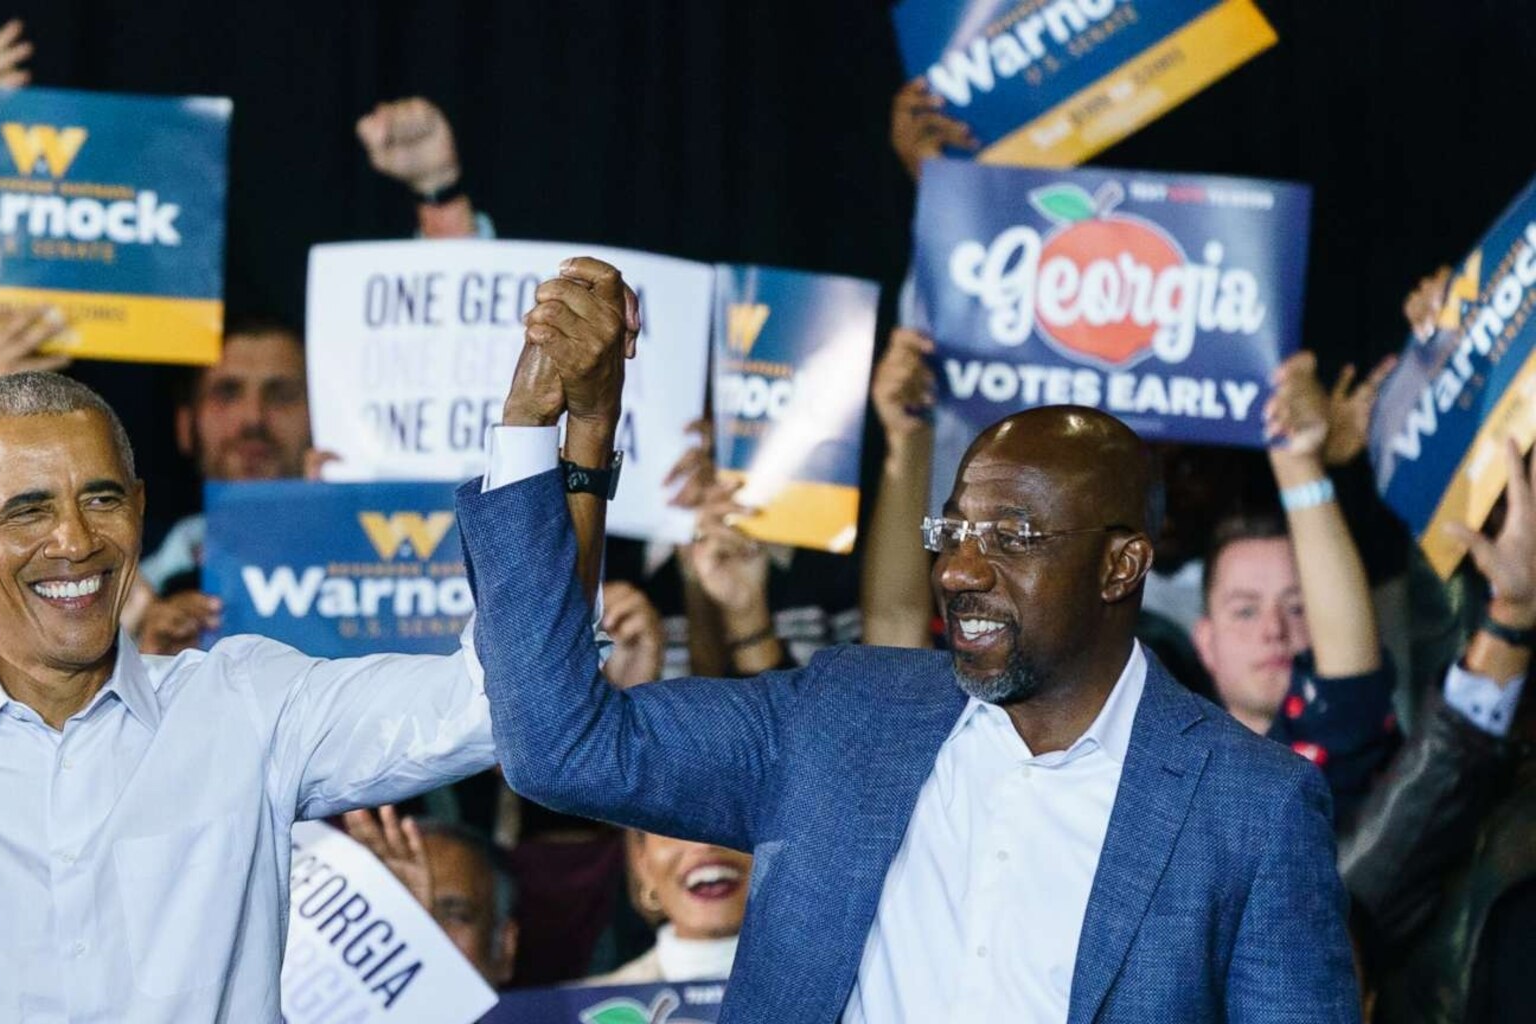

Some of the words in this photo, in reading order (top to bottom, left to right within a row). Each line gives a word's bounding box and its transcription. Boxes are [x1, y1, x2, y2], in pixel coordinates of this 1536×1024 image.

[364, 272, 445, 328] ONE
[949, 226, 1266, 364] Georgia
[945, 359, 1101, 409] VOTES
[1108, 371, 1259, 421] EARLY
